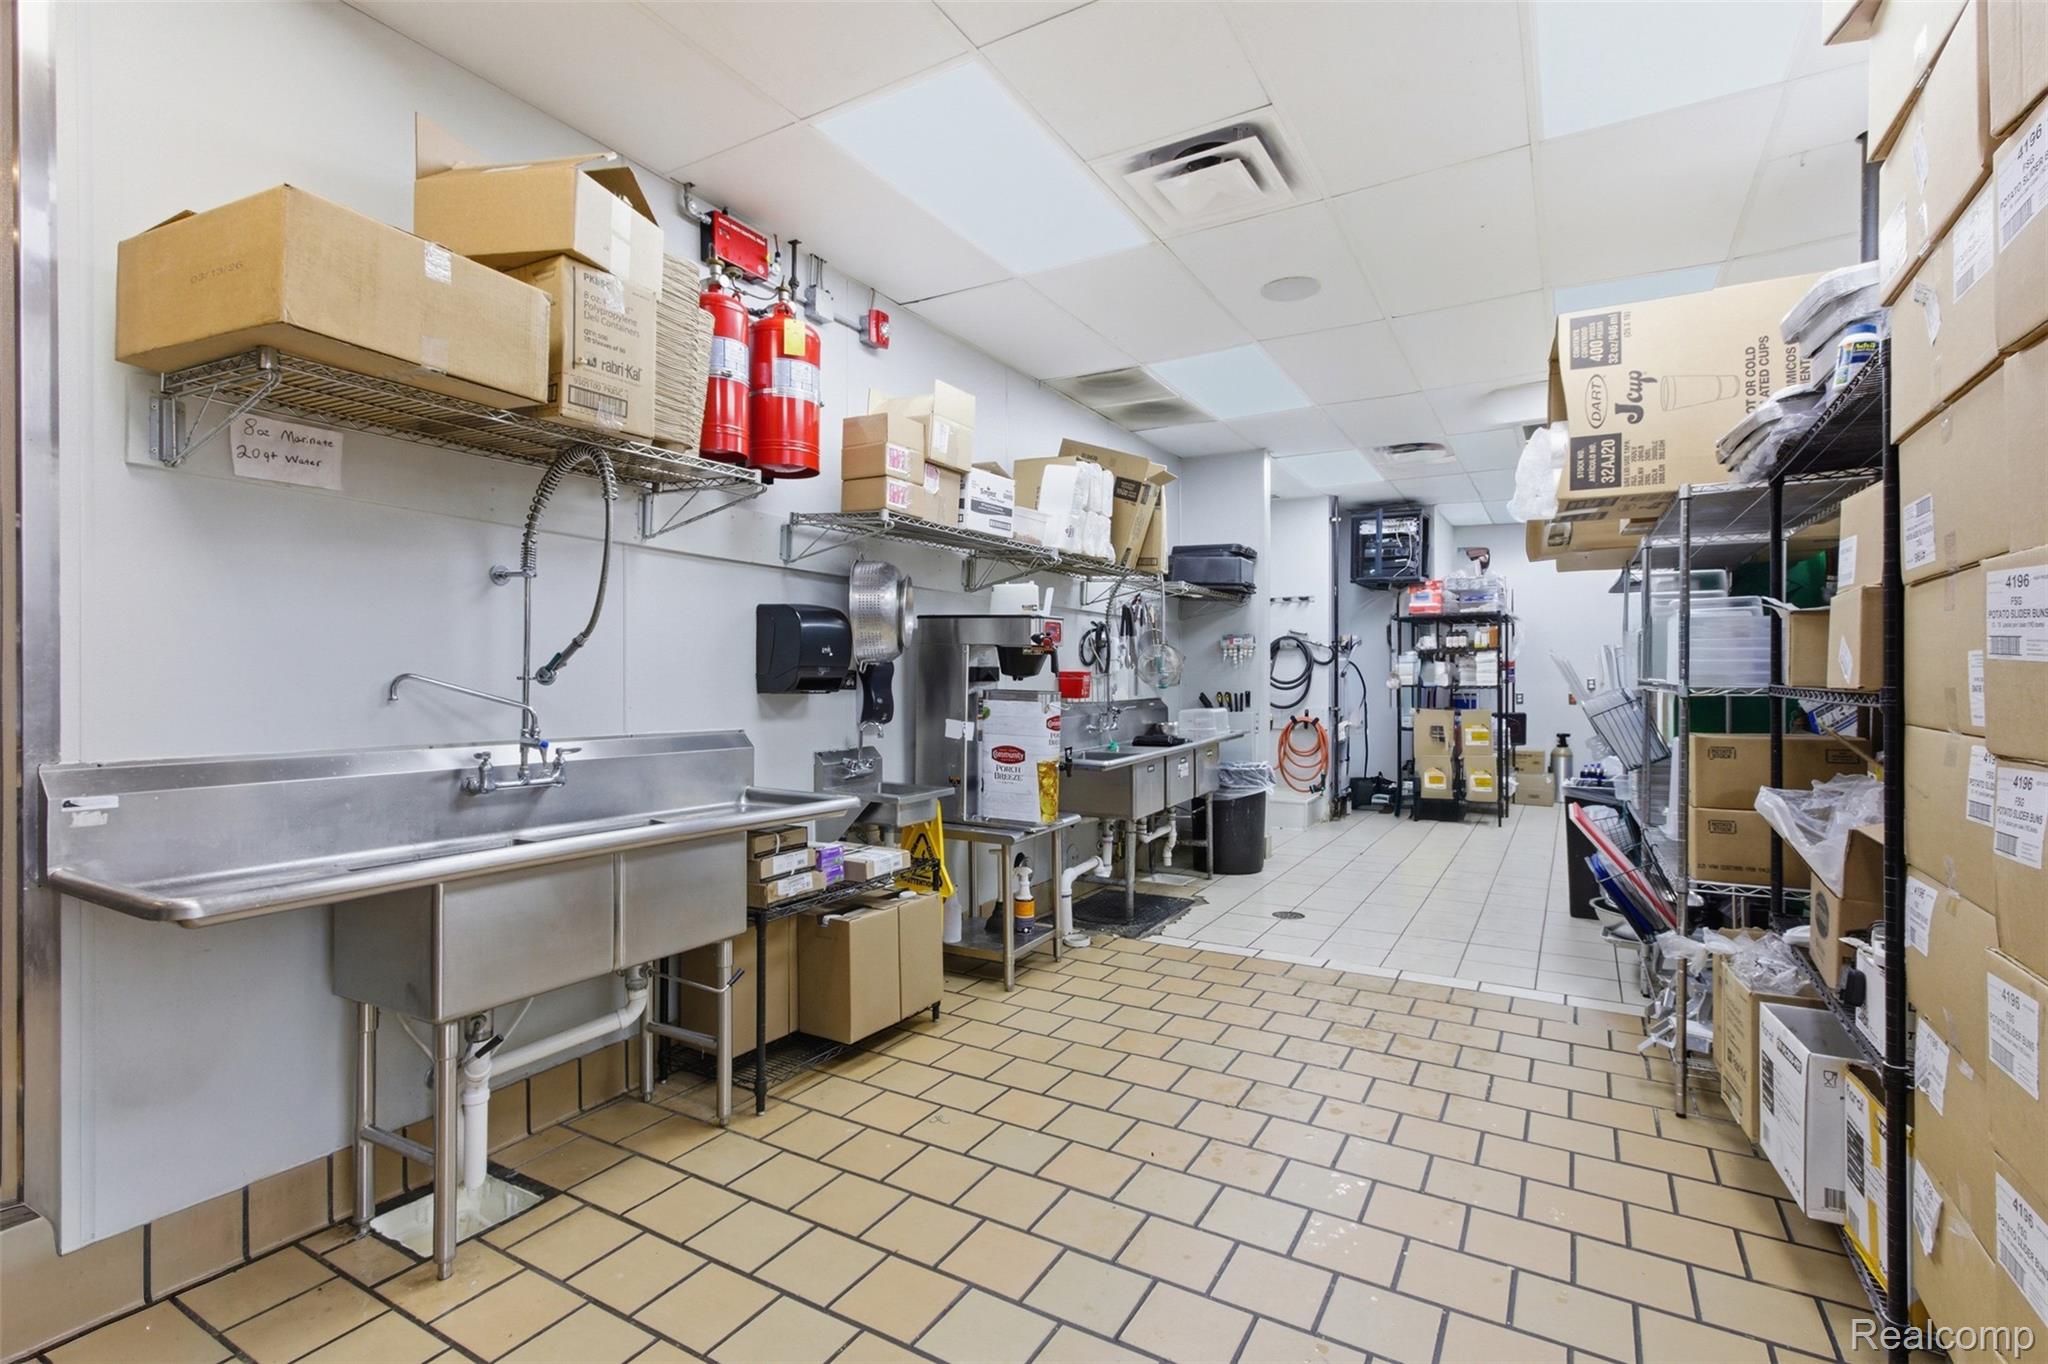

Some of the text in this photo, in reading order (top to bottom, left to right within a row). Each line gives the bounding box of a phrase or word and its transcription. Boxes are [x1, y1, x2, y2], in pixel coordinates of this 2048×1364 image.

[584, 300, 637, 327] Polypropylene
[584, 310, 640, 338] Deli Containers
[1589, 339, 1604, 361] 400
[1608, 352, 1618, 364] 32
[1759, 335, 1769, 366] CUPS
[1745, 347, 1756, 414] OT OR COLD
[1591, 382, 1602, 421] DART
[280, 429, 334, 448] Marinate
[285, 455, 322, 467] Water
[1601, 439, 1616, 484] 32AJ20
[2005, 573, 2030, 588] 4196
[1988, 609, 2009, 619] POTATO
[2010, 608, 2031, 618] SLIDER
[993, 749, 1024, 761] Community
[994, 772, 1023, 781] BREEZE
[995, 764, 1021, 773] PORCH
[2013, 775, 2034, 791] 4196
[1997, 805, 2043, 825] POTATO SLIDER BUNS
[2001, 988, 2020, 1010] 4196
[2013, 1198, 2033, 1229] 4196
